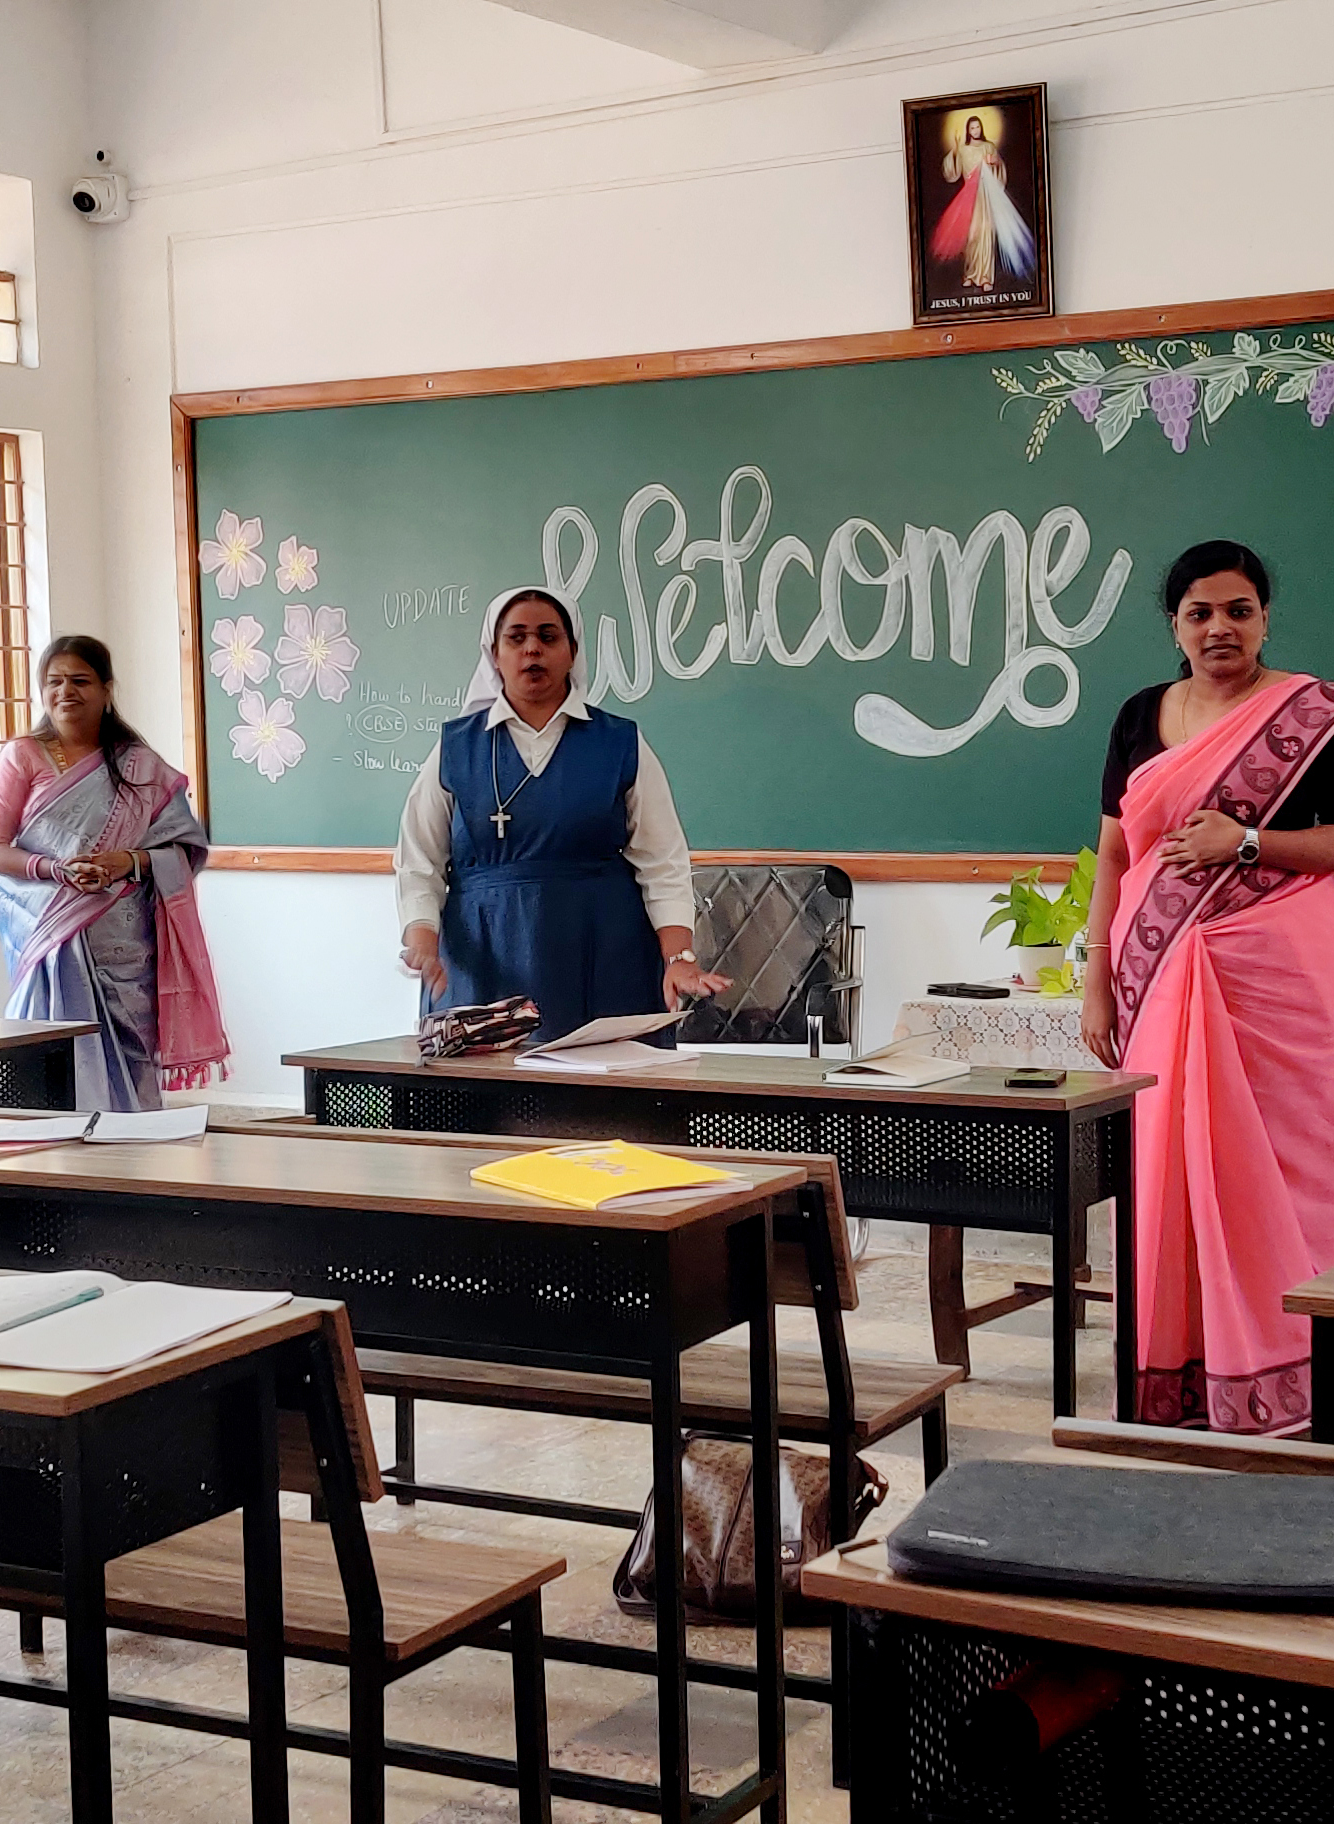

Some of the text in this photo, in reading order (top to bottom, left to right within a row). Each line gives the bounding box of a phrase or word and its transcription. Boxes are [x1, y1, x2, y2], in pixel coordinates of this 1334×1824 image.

[930, 298, 960, 309] JESUS,
[968, 294, 997, 306] TRUST
[999, 293, 1010, 303] IN
[1012, 290, 1032, 301] YOU
[383, 585, 470, 629] UPDATE
[542, 465, 1134, 757] Welcome
[359, 681, 467, 707] How to handl
[363, 715, 403, 732] CBSE
[354, 750, 424, 772] Slow lear
